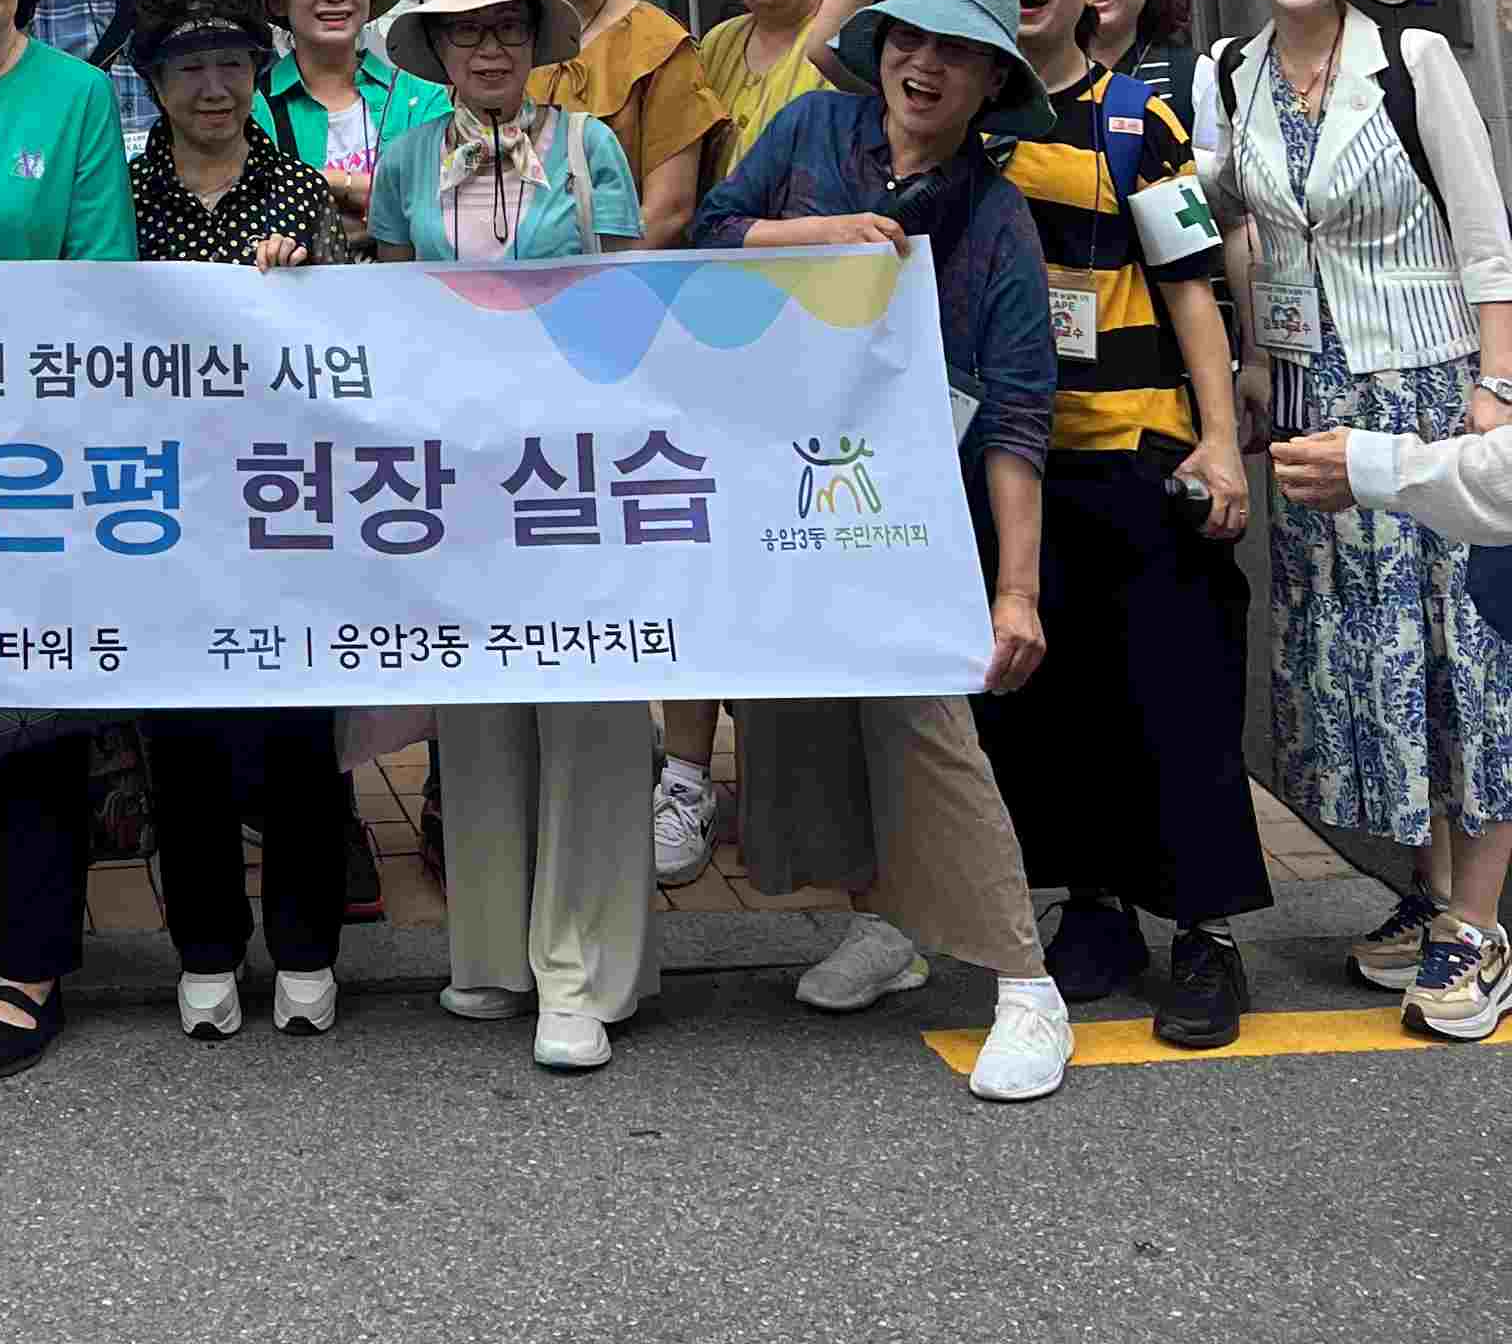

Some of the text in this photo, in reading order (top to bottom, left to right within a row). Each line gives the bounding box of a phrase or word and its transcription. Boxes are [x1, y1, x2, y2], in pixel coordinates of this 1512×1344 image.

[28, 341, 249, 400] 참여예산
[270, 343, 373, 400] 사업
[235, 437, 457, 556] 현장
[500, 429, 717, 548] 실습
[760, 527, 827, 552] 응암3동
[88, 625, 129, 673] 등
[208, 625, 287, 671] 주관
[329, 623, 470, 669] 응암3동
[484, 617, 680, 667] 주민자치회
